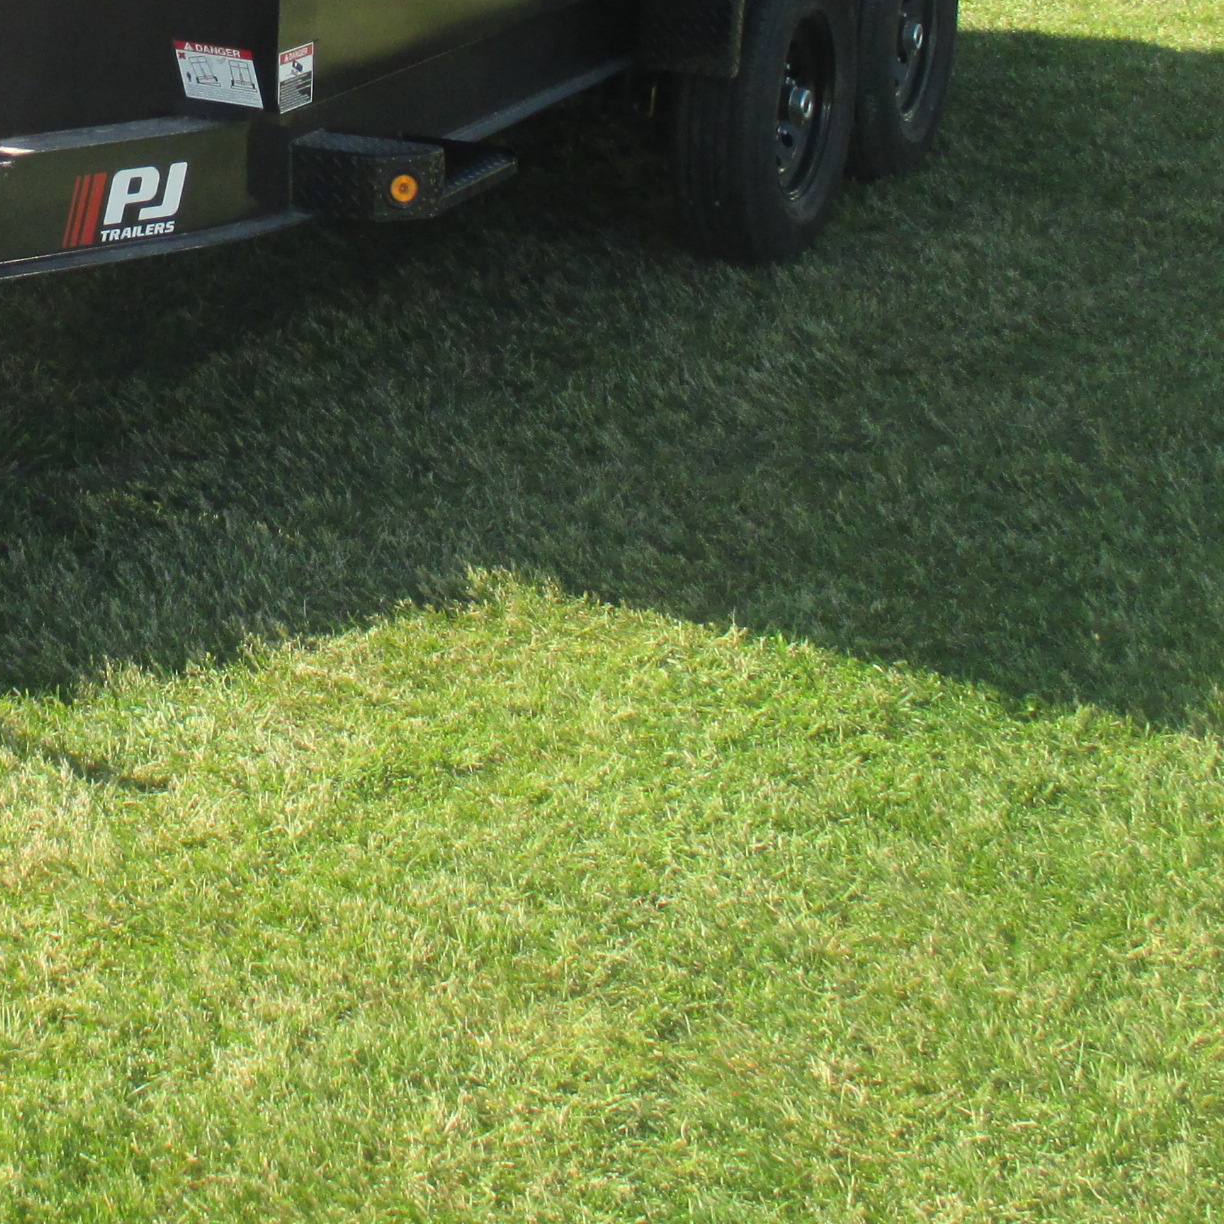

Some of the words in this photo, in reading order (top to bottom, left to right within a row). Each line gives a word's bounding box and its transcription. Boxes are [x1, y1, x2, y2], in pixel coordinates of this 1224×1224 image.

[195, 44, 241, 58] DANGER
[287, 48, 309, 60] DANGER
[103, 161, 188, 225] PJ
[100, 221, 176, 243] TRAILERS
